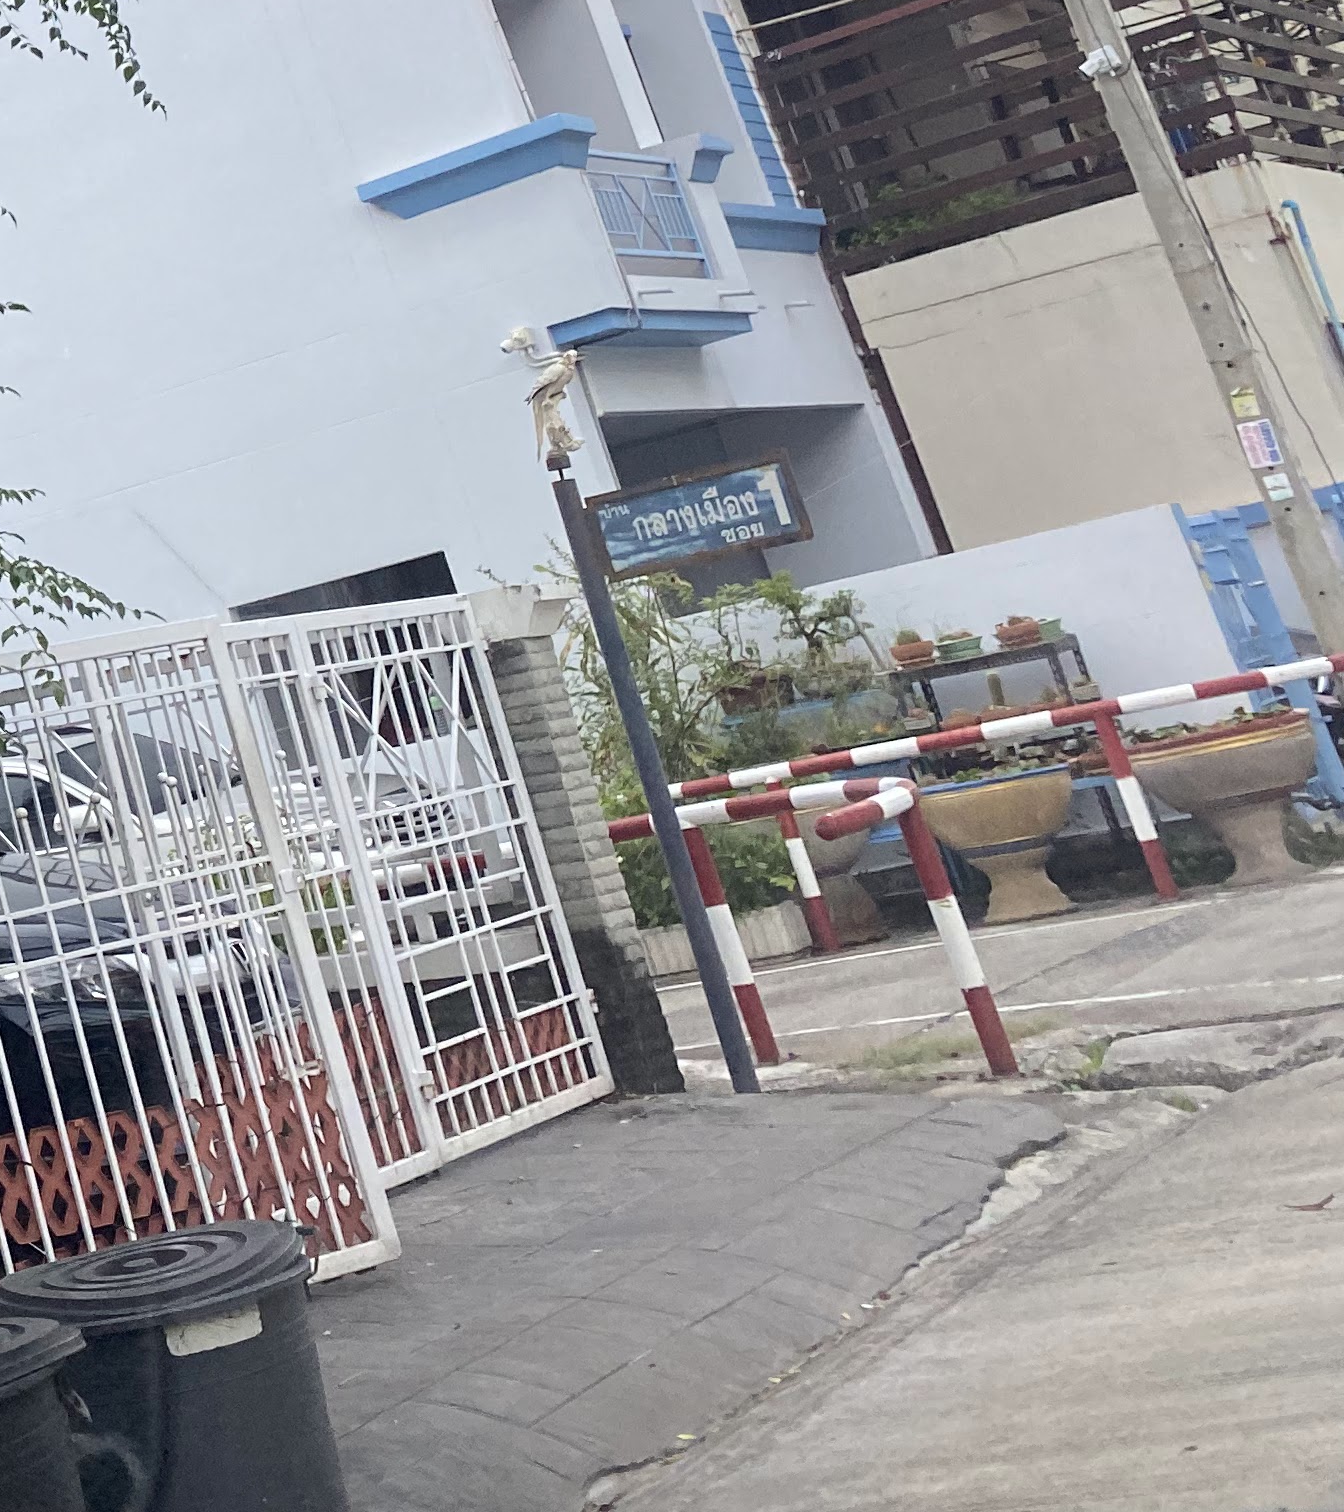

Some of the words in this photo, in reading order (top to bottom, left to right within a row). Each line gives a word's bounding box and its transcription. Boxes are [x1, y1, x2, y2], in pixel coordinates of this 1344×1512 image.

[598, 503, 631, 520] บ้าน
[632, 486, 760, 541] กลางเมือง
[757, 470, 792, 526] 1
[720, 521, 766, 544] ซอย
